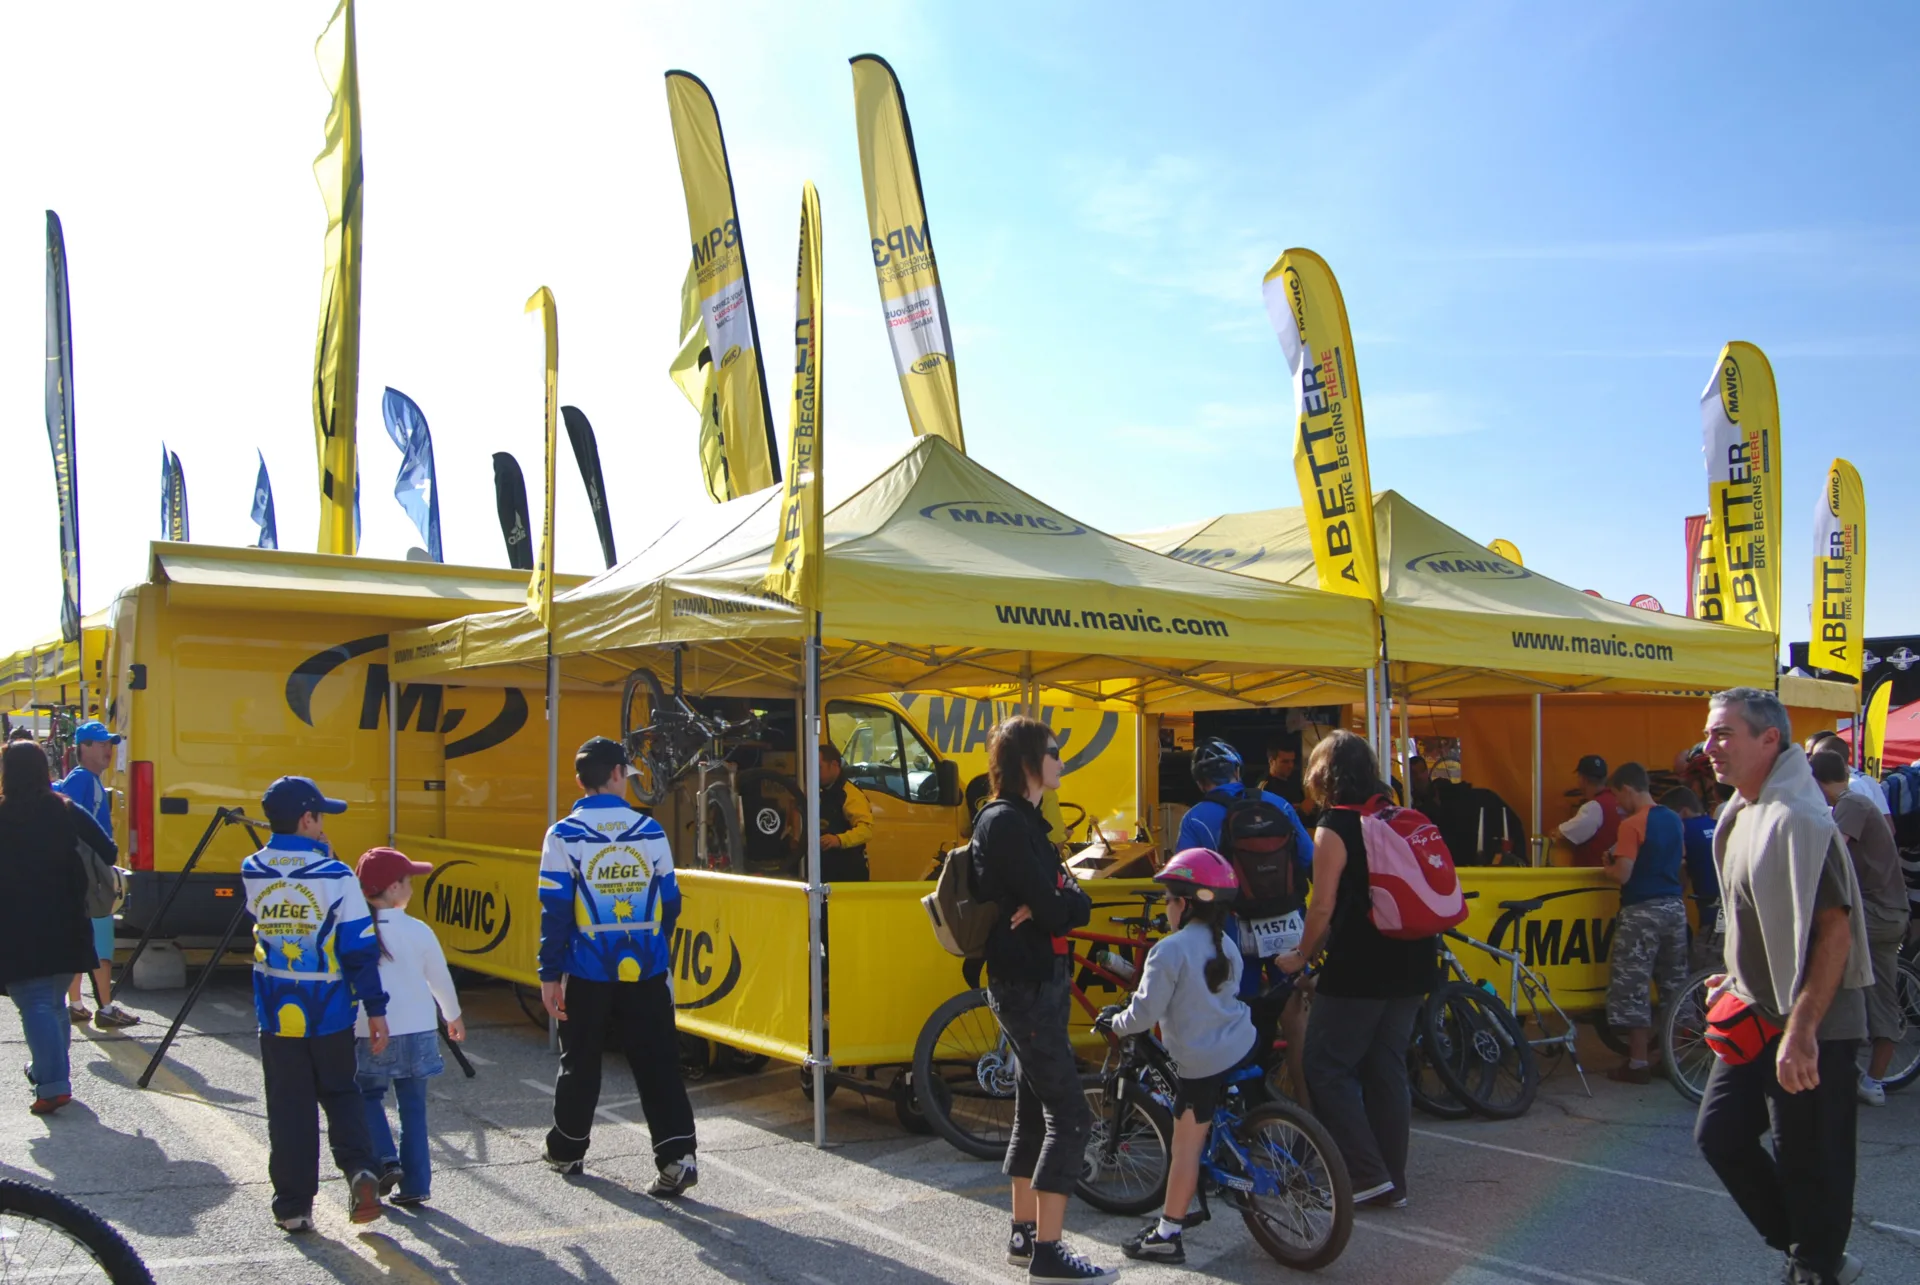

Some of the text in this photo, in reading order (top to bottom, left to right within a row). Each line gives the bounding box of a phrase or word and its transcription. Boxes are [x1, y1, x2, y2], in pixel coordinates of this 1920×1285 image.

[692, 218, 739, 271] MP3
[1321, 348, 1339, 397] HERE
[1725, 367, 1739, 413] MAVIC
[799, 362, 815, 437] BEGINS
[1330, 402, 1350, 467] BEGINS
[1300, 363, 1360, 584] A BETTER
[1341, 472, 1356, 513] BIKE
[1832, 476, 1840, 510] MAVIC
[947, 508, 1064, 532] MAVIC
[1749, 430, 1765, 569] BIKE BEGINS HERE
[1721, 441, 1760, 629] A BETTER
[1426, 559, 1515, 575] MAVIC
[1822, 530, 1847, 661] A BETTER
[995, 604, 1229, 637] www.mavic.com
[1511, 631, 1675, 661] www.mavic.com
[926, 696, 1074, 754] MAC
[1411, 831, 1442, 846] Rip Cu
[598, 861, 640, 880] MÈGE
[261, 898, 311, 920] MÈGE
[436, 883, 495, 935] MAVIC
[1254, 917, 1298, 936] 11574
[1524, 918, 1617, 967] MAV
